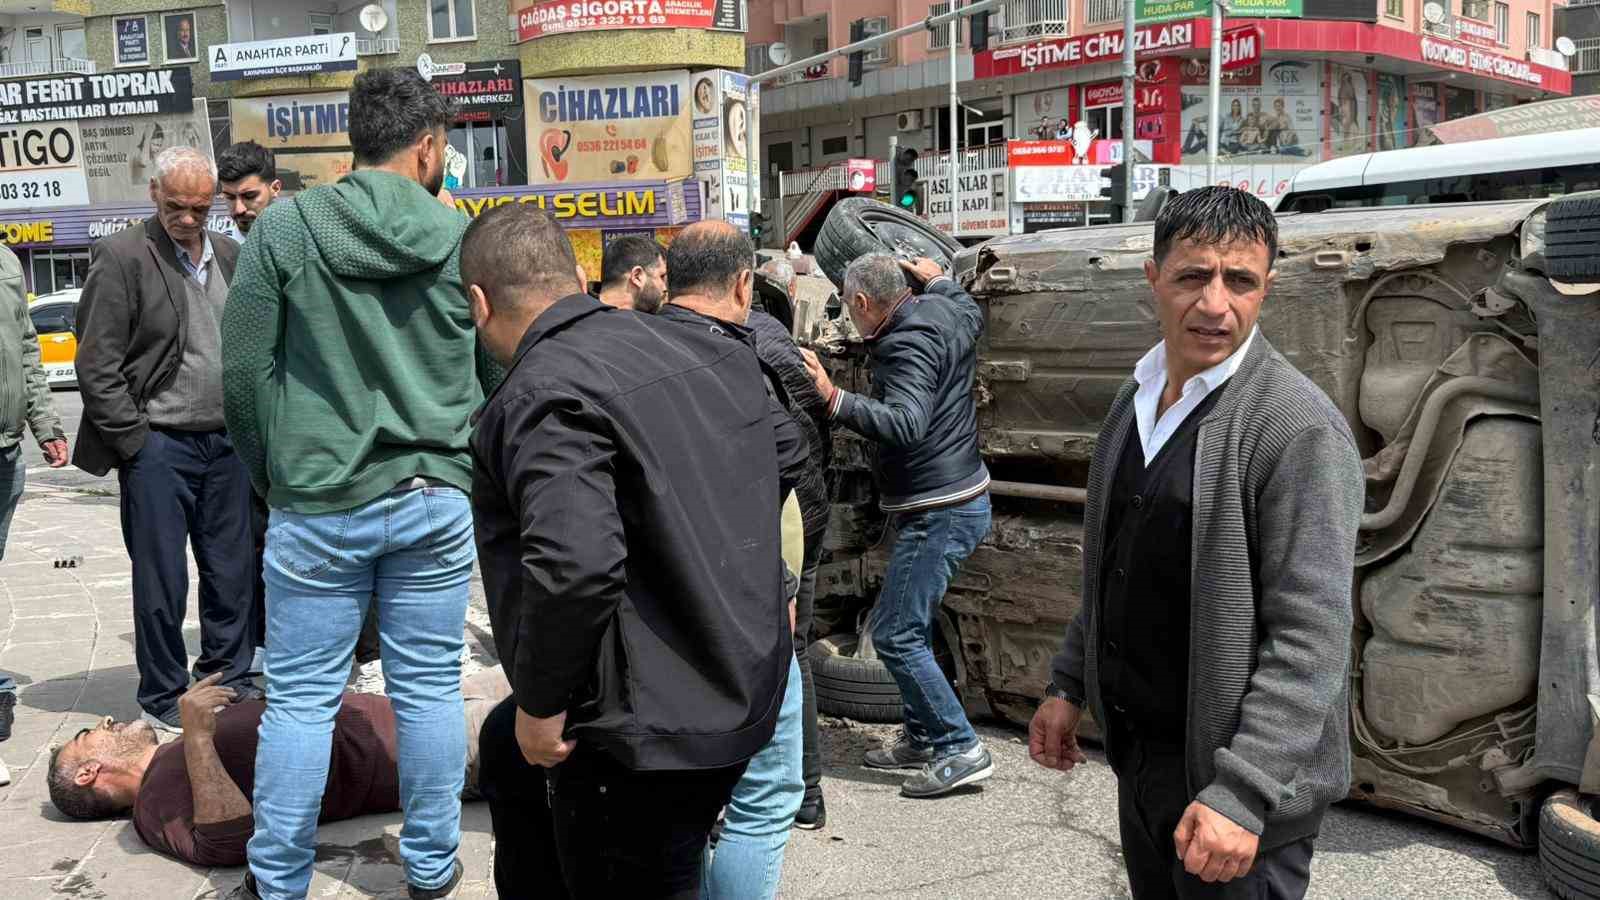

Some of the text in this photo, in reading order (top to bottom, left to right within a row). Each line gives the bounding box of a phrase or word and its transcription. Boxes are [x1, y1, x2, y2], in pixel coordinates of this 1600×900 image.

[600, 15, 624, 25] 323
[236, 46, 292, 61] ANAHTAR
[1020, 23, 1192, 72] İŞİTME CİHZLARI
[89, 70, 175, 99] TOPRAK
[21, 103, 106, 122] HASTALIKLARI
[109, 99, 159, 116] UZMANI
[540, 84, 678, 123] CİHAZLARI
[0, 181, 61, 200] 03 32 18
[931, 174, 988, 195] ASLNLAR
[930, 197, 989, 217] ÇELİ KAPI
